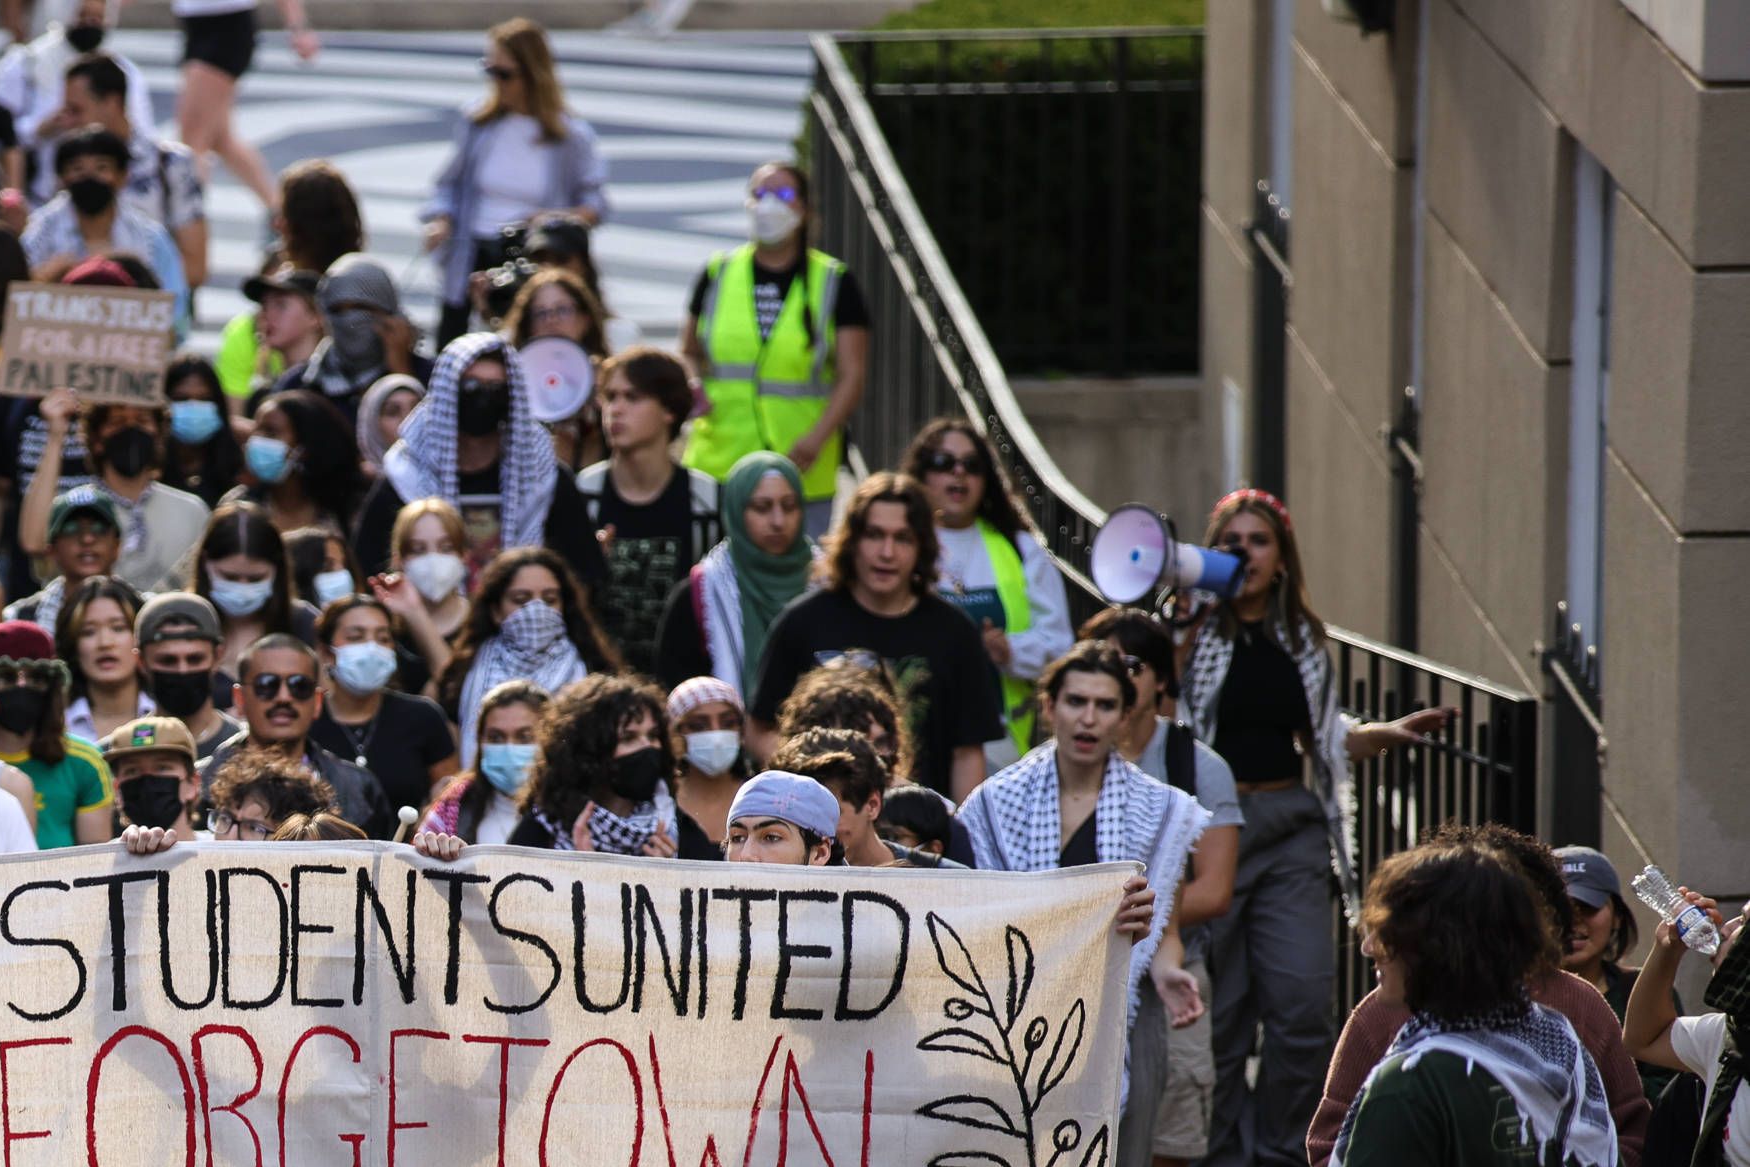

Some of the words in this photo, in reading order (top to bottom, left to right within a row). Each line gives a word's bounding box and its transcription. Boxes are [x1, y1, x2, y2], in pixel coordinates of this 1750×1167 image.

[12, 290, 100, 326] TRANS
[19, 327, 74, 355] FOR
[78, 334, 97, 357] A
[100, 333, 164, 365] FREE
[5, 357, 161, 401] PALESTINE
[0, 864, 563, 1023] STUDENTS
[571, 880, 912, 1022] UNITED
